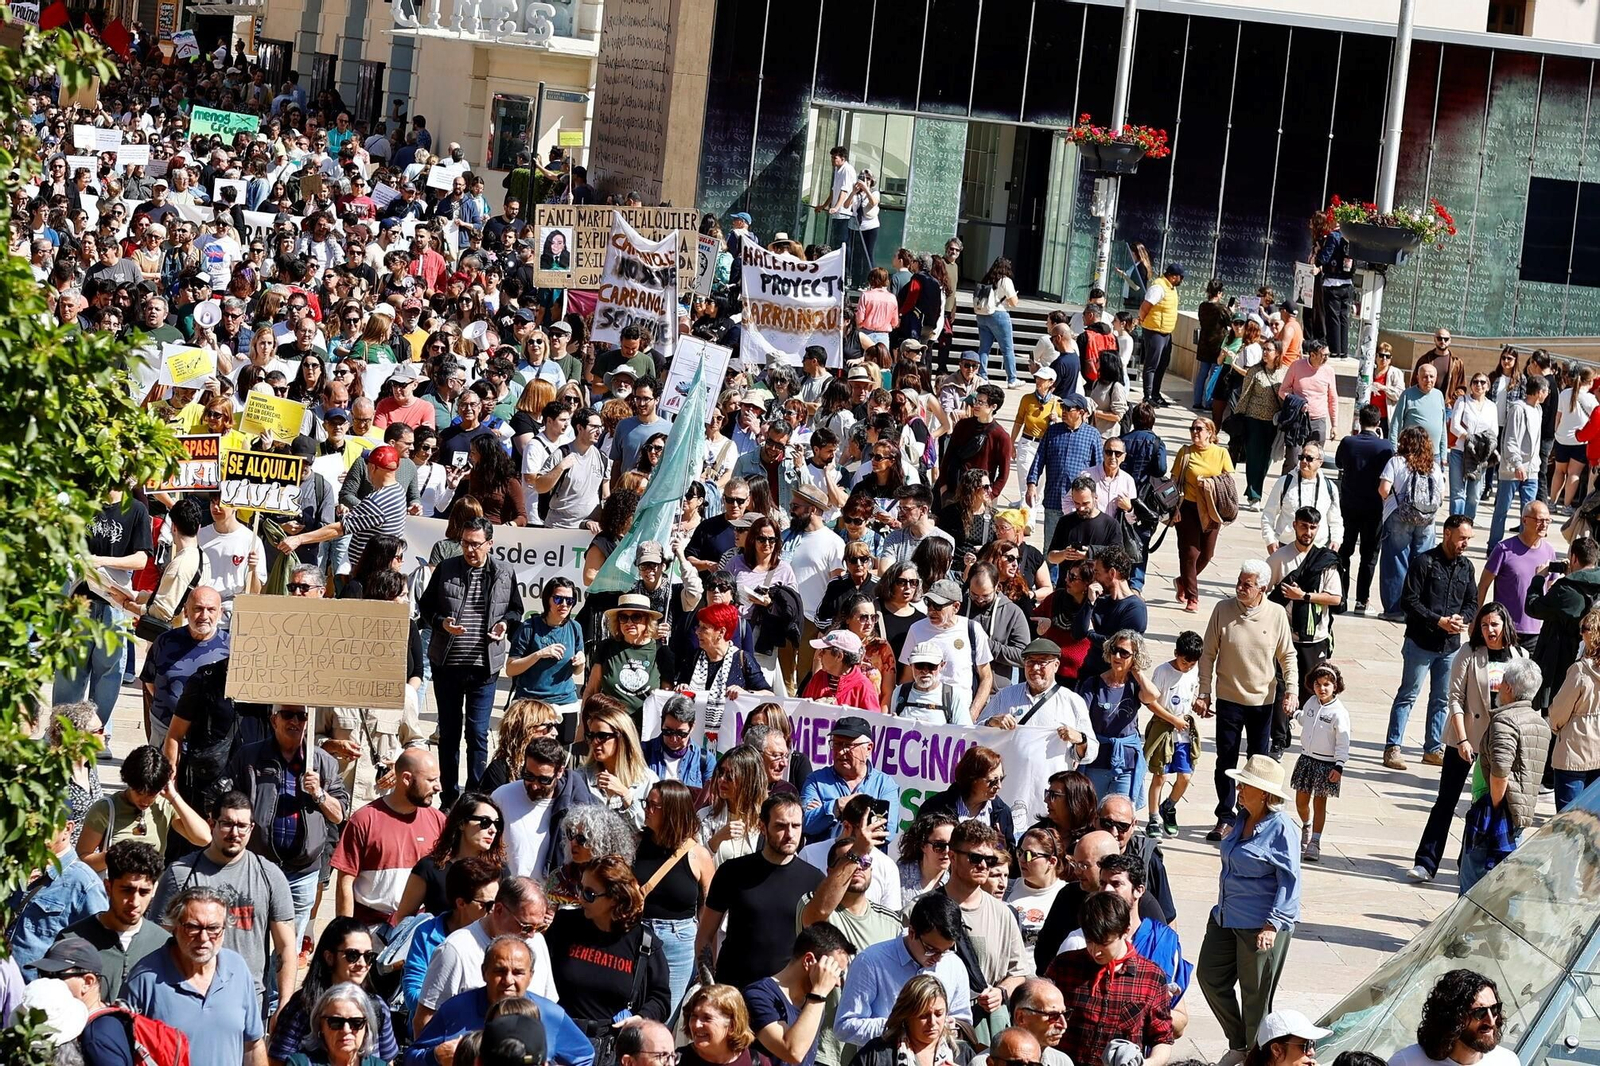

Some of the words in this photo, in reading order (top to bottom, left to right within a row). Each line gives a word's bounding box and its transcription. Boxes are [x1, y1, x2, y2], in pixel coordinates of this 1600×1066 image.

[194, 110, 230, 124] menos
[228, 454, 244, 474] SE
[245, 456, 296, 483] ALQUILA
[544, 545, 564, 568] el
[236, 612, 278, 636] LAS
[282, 614, 357, 638] CASAS
[362, 616, 404, 640] PARA
[233, 636, 268, 654] LOS
[232, 654, 288, 669] HOTELES
[294, 655, 336, 670] PARA
[342, 657, 377, 672] LOS
[231, 667, 324, 685] TURISTAS
[568, 944, 633, 974] GENERATION
